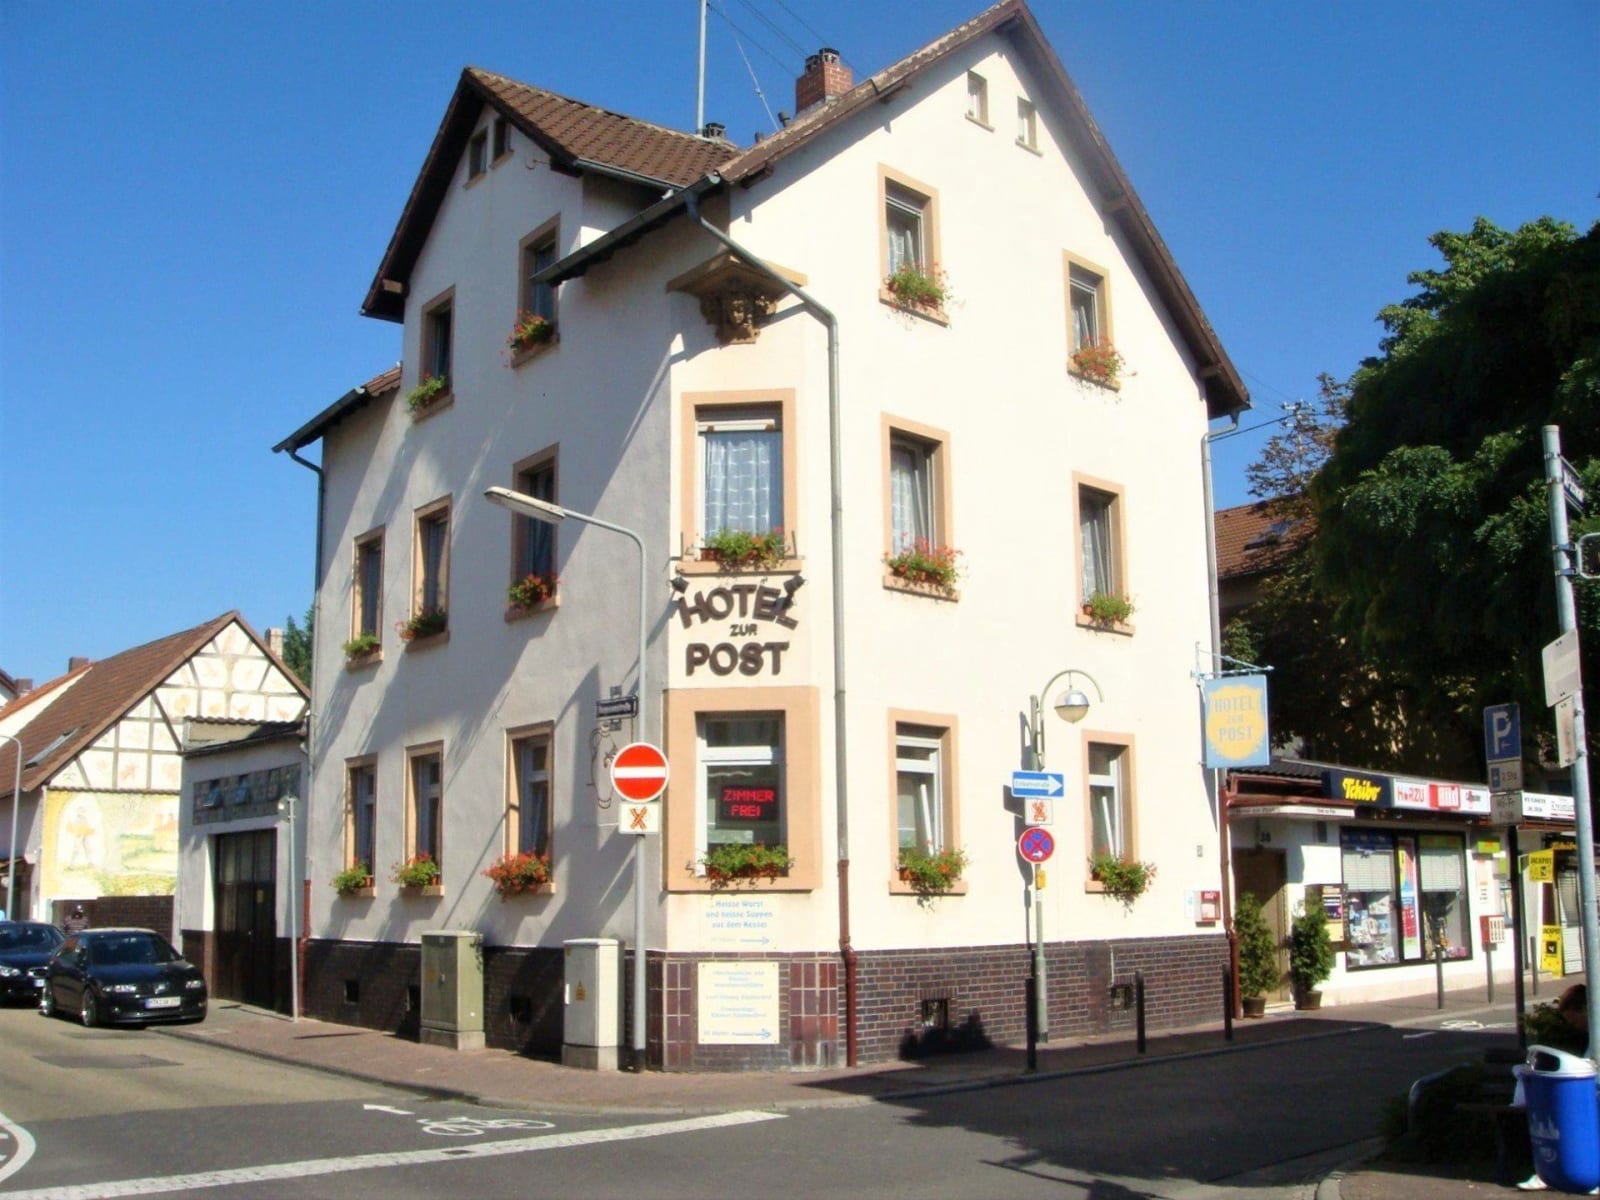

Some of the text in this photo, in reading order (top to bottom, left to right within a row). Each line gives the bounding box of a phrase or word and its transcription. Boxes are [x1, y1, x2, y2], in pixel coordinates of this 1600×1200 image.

[679, 584, 799, 630] HOTEL
[729, 624, 758, 637] ZUR
[685, 641, 790, 677] POST
[723, 788, 775, 802] ZIMMER
[1343, 777, 1382, 802] Tchibo
[731, 804, 761, 817] FREI
